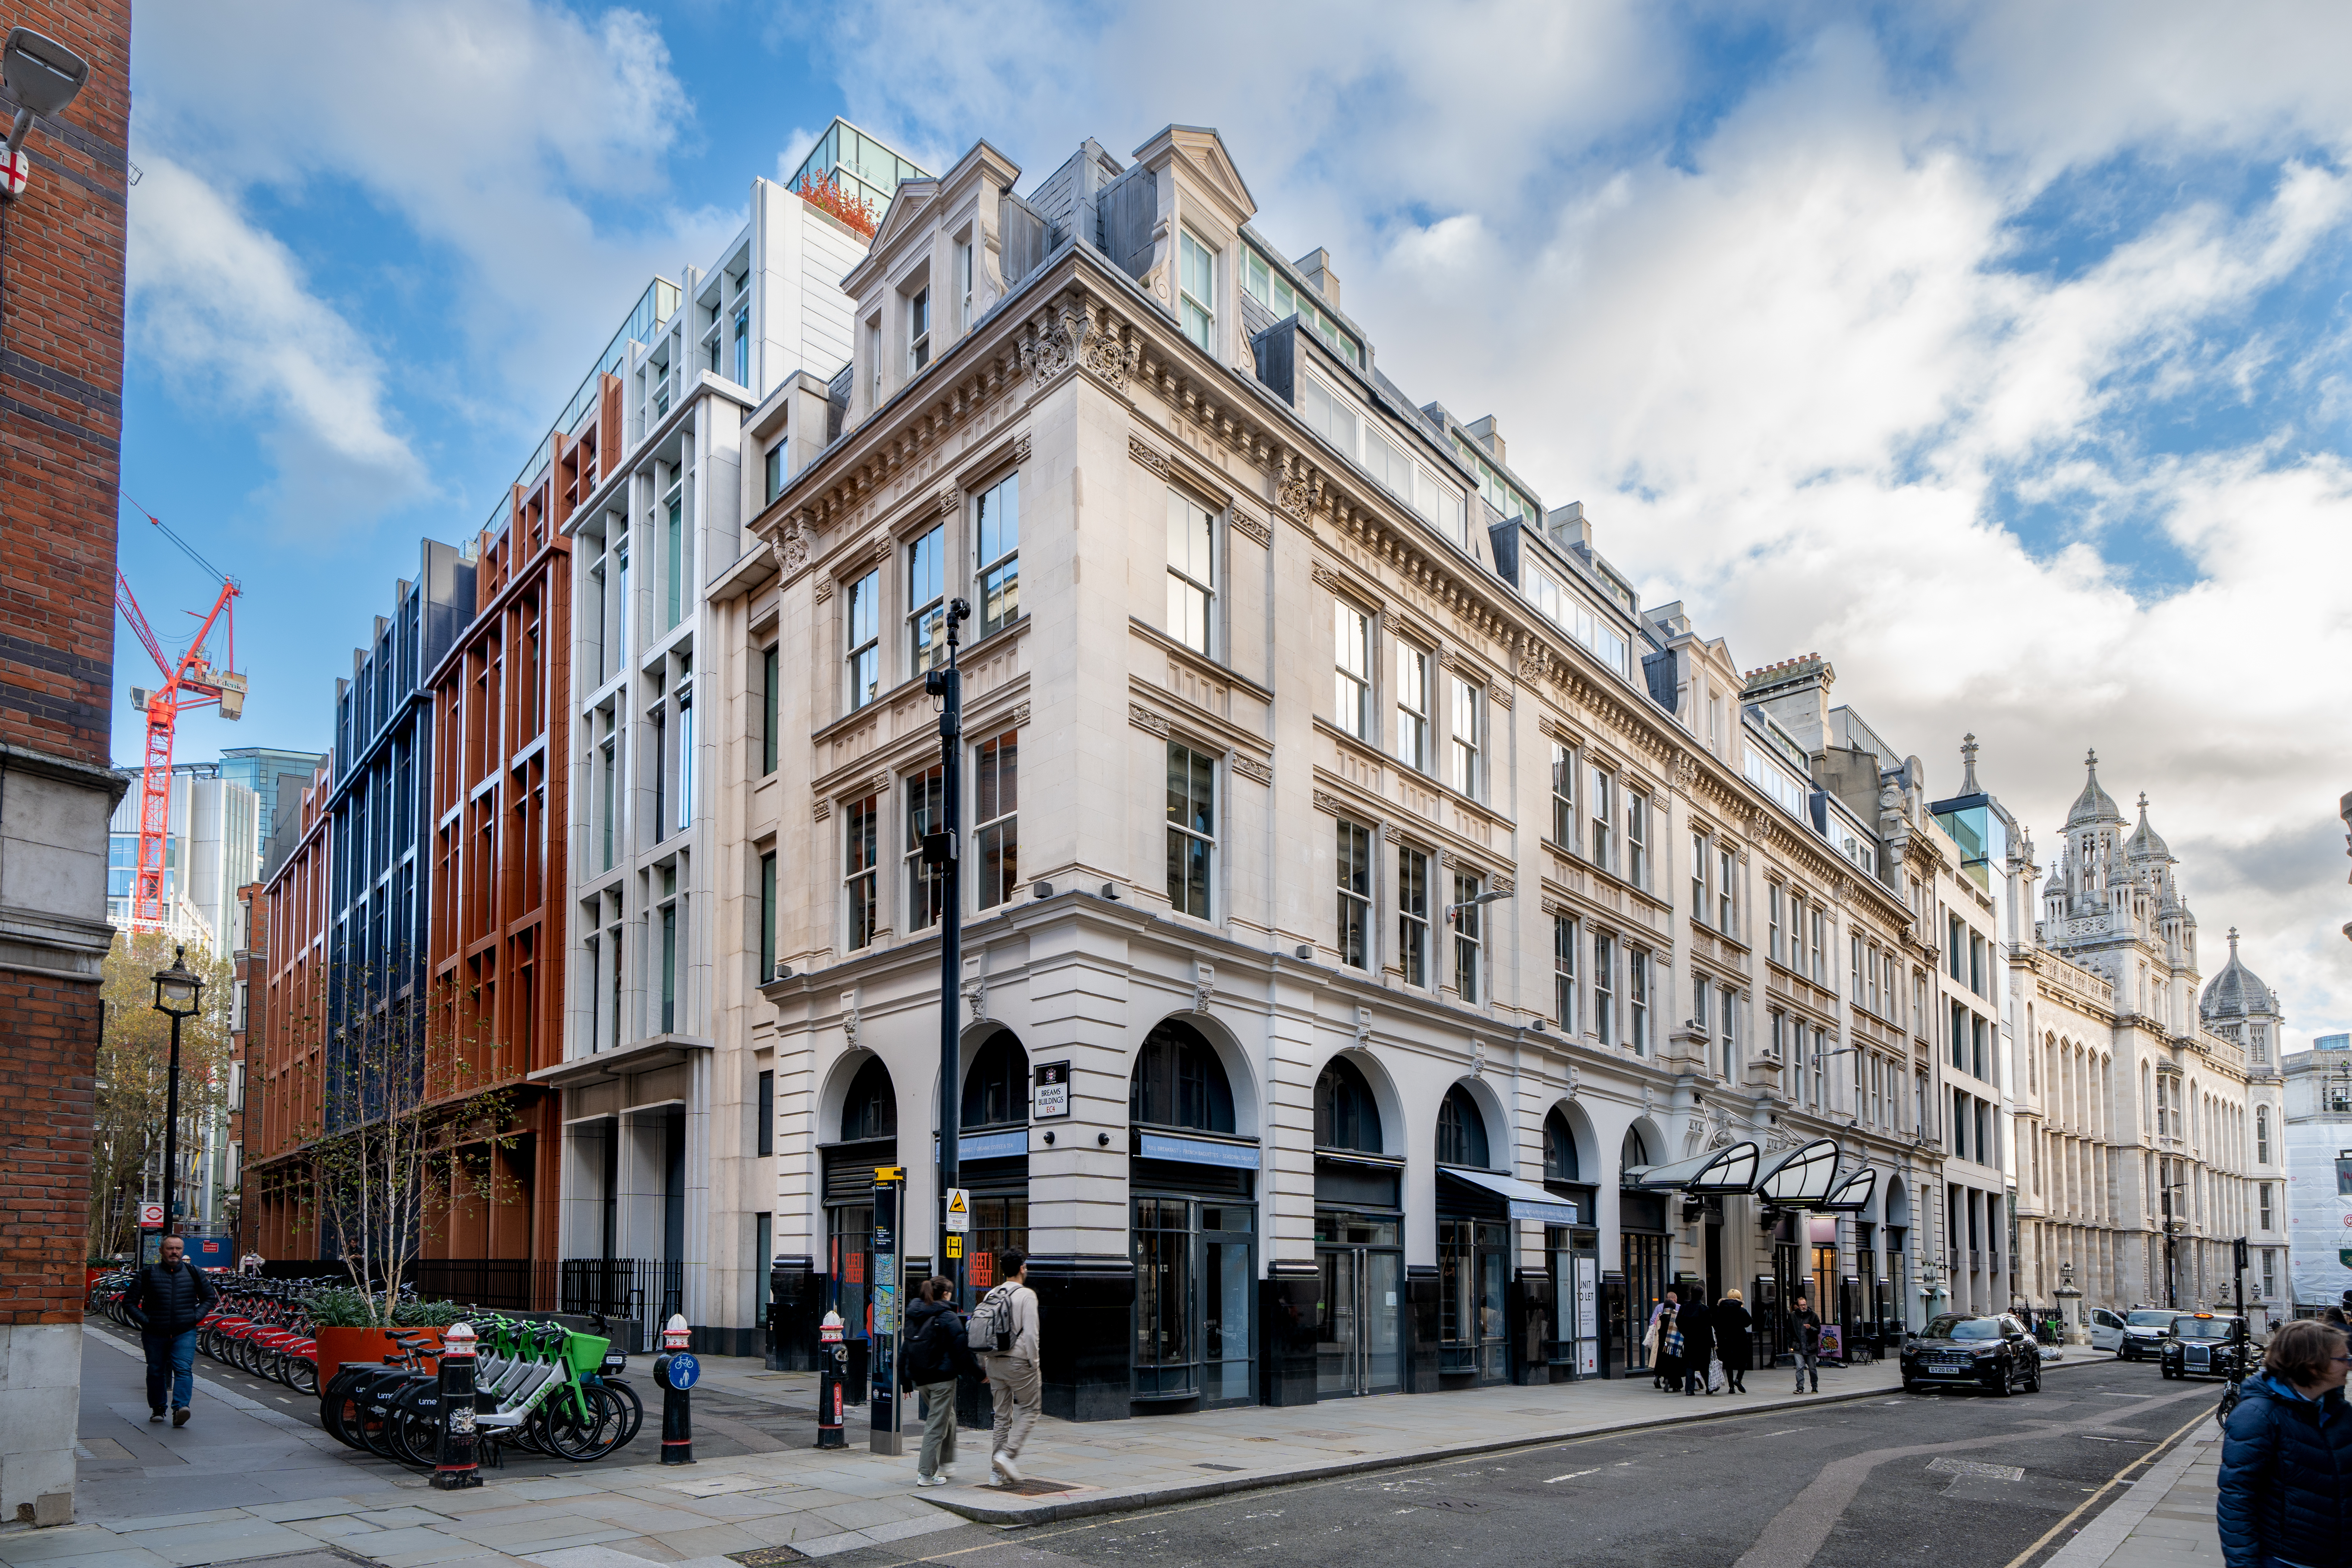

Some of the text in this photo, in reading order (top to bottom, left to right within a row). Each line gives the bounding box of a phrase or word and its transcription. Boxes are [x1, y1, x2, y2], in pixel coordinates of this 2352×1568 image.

[217, 679, 247, 692] Edenica
[1041, 1088, 1060, 1097] BREAMS
[1038, 1096, 1063, 1106] BUILDINGS
[846, 1253, 860, 1268] FLEET
[969, 1253, 988, 1269] FLEET
[969, 1269, 993, 1286] STREET
[1585, 1292, 1594, 1301] LET
[525, 1382, 553, 1409] Lime
